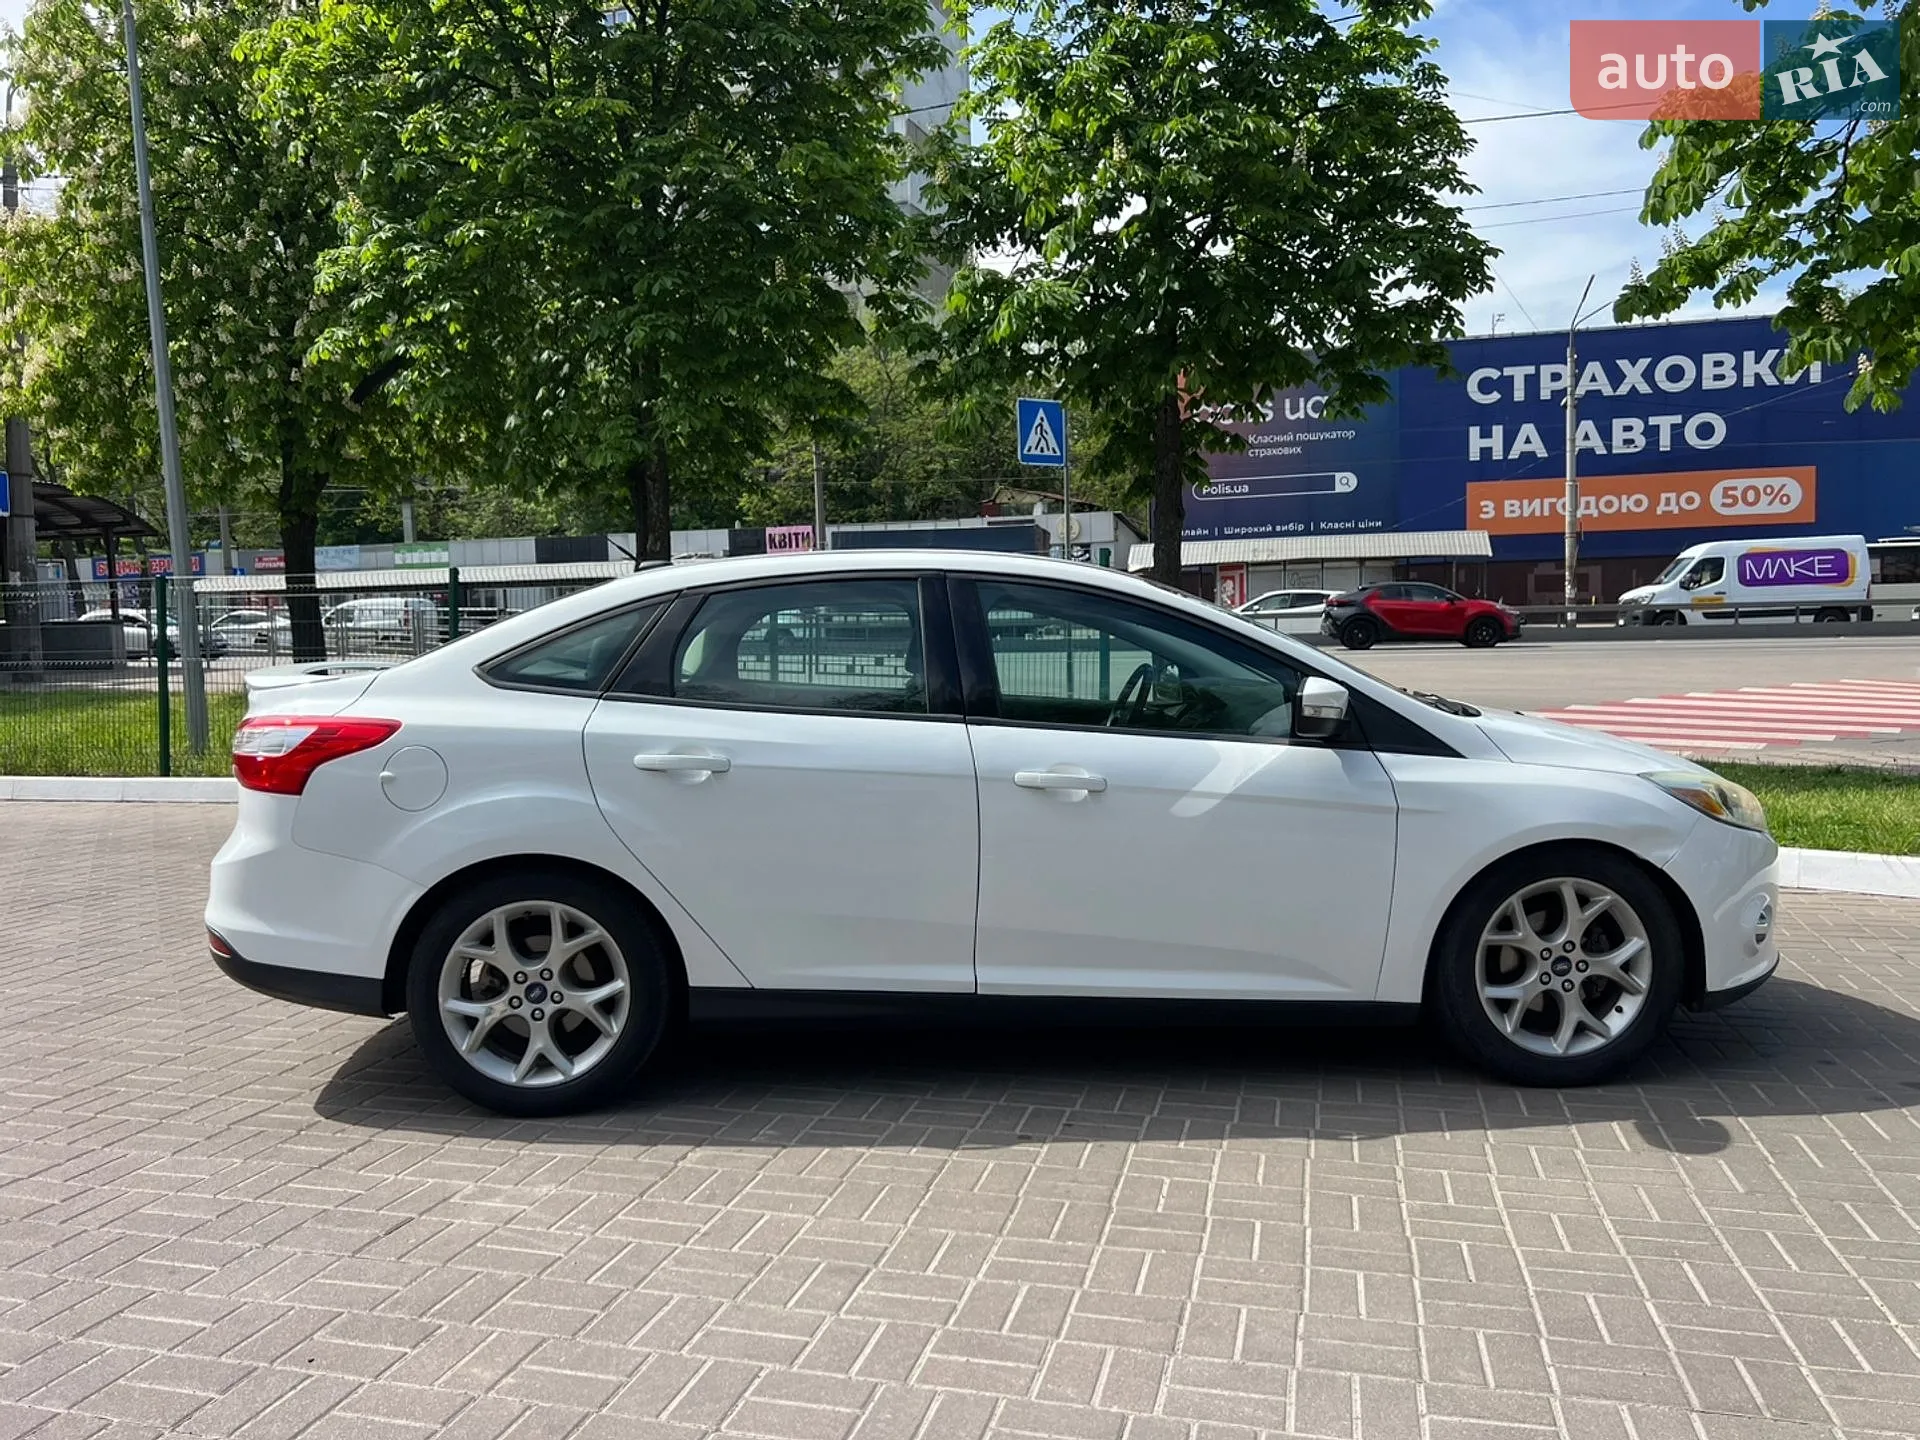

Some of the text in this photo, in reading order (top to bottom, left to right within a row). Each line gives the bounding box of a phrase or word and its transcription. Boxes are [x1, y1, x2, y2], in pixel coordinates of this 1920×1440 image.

[1466, 346, 1823, 404] СТРАХОВКИ
[1248, 428, 1356, 444] Класний пошукатор
[1468, 412, 1727, 461] НА АВТО
[1248, 445, 1302, 457] страхових
[1504, 494, 1648, 519] ВИГОДОЮ
[1656, 491, 1701, 515] ДО
[1720, 484, 1791, 508] 50%
[1275, 522, 1305, 533] вибір
[1320, 520, 1356, 530] Класні
[1358, 519, 1383, 530] ціни
[769, 533, 811, 550] КВІТИ
[1744, 555, 1840, 583] MAKE
